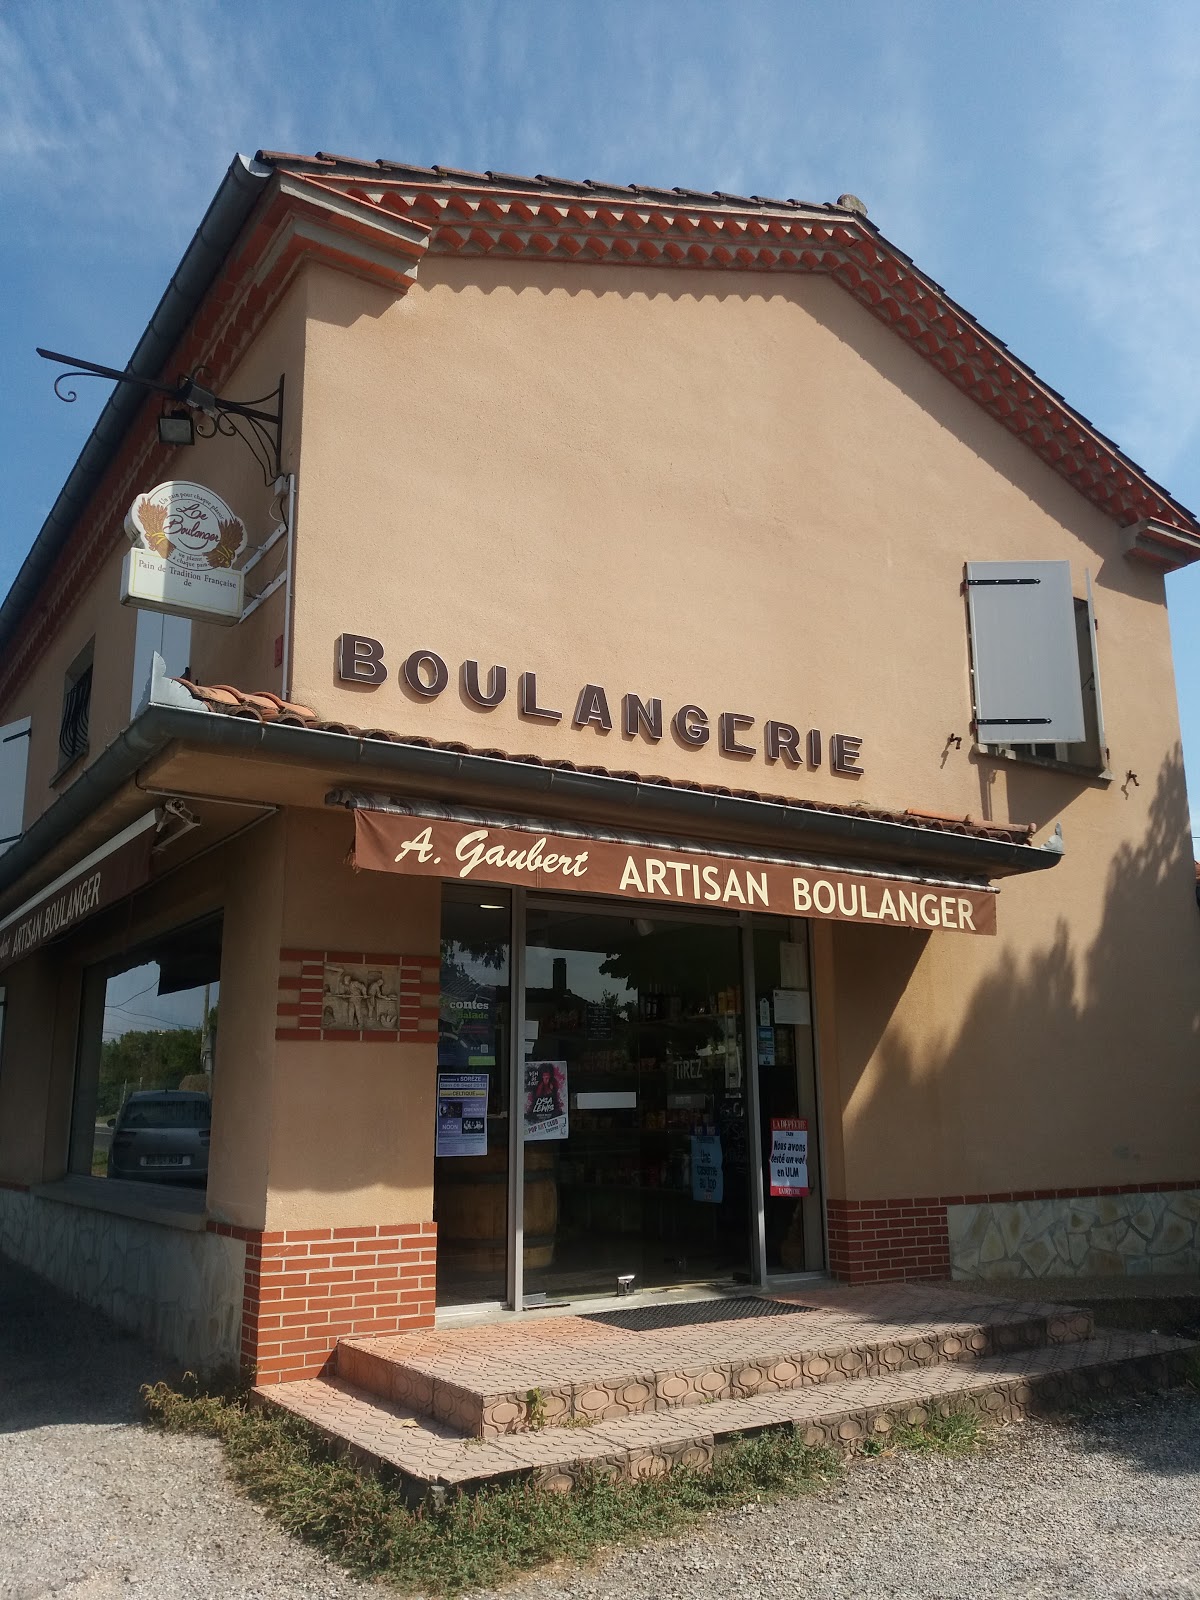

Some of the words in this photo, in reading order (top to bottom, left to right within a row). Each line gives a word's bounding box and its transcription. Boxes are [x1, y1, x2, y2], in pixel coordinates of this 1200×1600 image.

[175, 503, 209, 521] Le
[162, 513, 220, 543] Boulanger
[138, 560, 155, 570] Pain
[157, 564, 166, 573] de
[169, 566, 201, 581] Tradition
[204, 574, 237, 589] Française
[183, 579, 192, 587] de
[394, 825, 442, 865] A.
[454, 829, 590, 878] Gaubert
[618, 855, 770, 907] ARTISAN
[792, 877, 977, 931] BOULANGER
[11, 911, 43, 958] ARTISAN
[43, 871, 102, 938] BOULANGER
[449, 1001, 490, 1010] contes
[773, 1140, 787, 1151] Nous
[787, 1143, 806, 1153] avons
[771, 1153, 785, 1164] testé
[795, 1155, 806, 1165] vol
[777, 1169, 785, 1177] en
[785, 1167, 800, 1178] ULM
